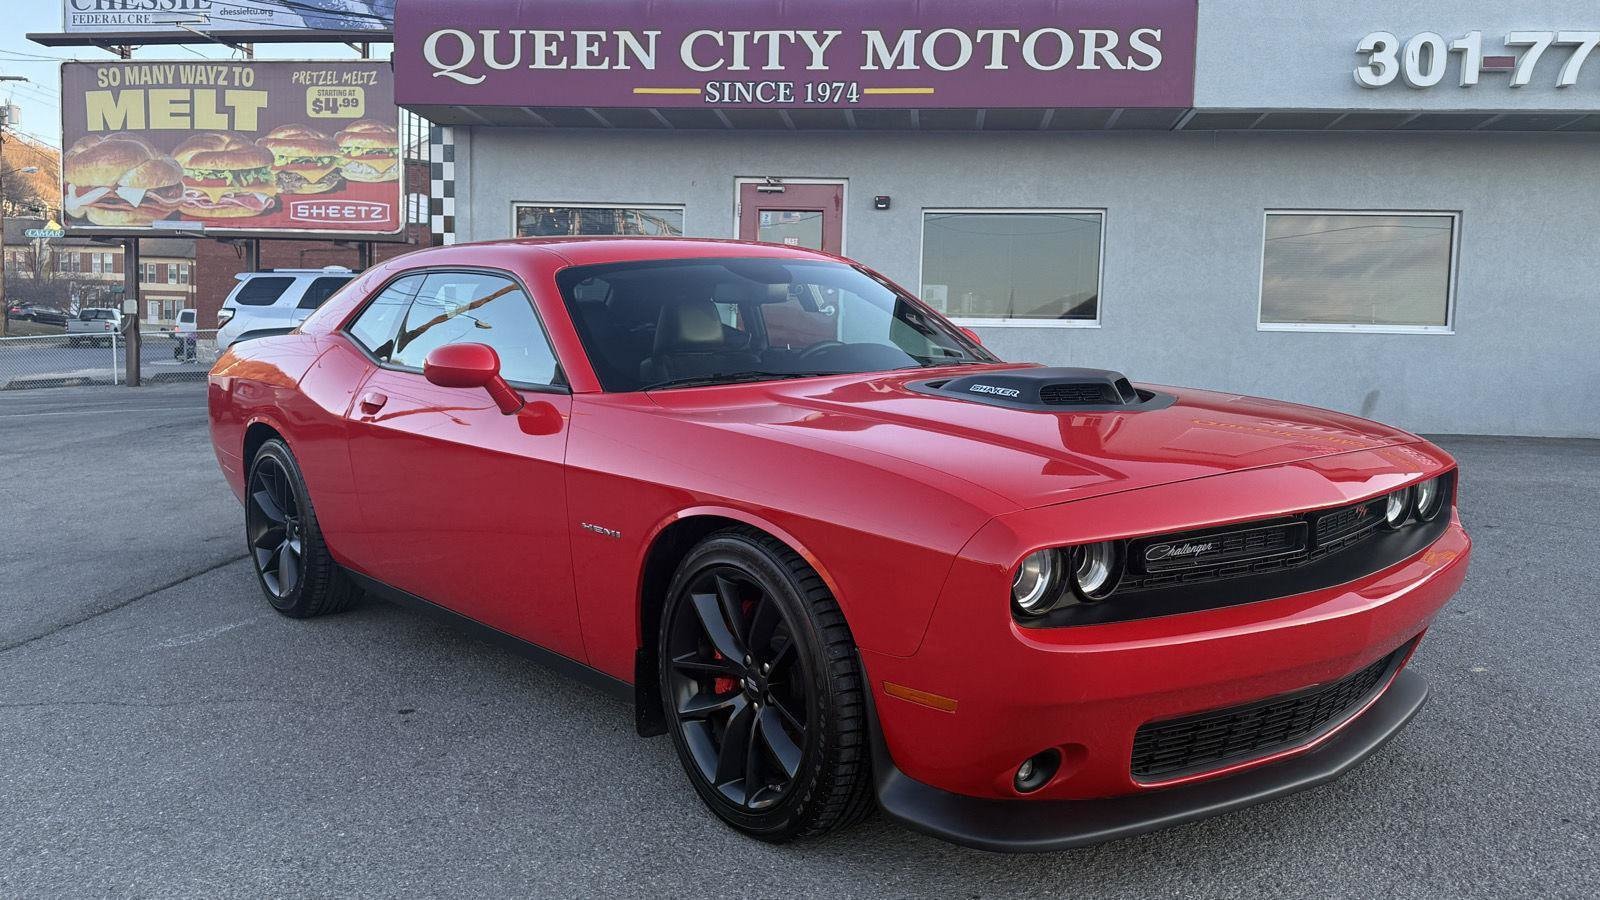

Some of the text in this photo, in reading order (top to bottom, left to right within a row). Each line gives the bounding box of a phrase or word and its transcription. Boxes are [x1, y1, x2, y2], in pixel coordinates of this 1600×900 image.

[72, 14, 125, 24] FEDERAL
[219, 7, 274, 18] chessiefcu.org
[423, 28, 1163, 85] QUEEN CITY MOTORS
[97, 65, 255, 88] SO MANY WAYZ TO
[292, 70, 378, 86] PRETZEL MELTZ
[317, 89, 356, 97] STARTING AT
[704, 81, 860, 104] SINCE 1974
[85, 88, 268, 132] MELT
[312, 97, 359, 115] $4.99
[297, 204, 383, 219] SHEETZ
[969, 384, 1020, 398] SHAKER
[1145, 543, 1212, 561] Challenger
